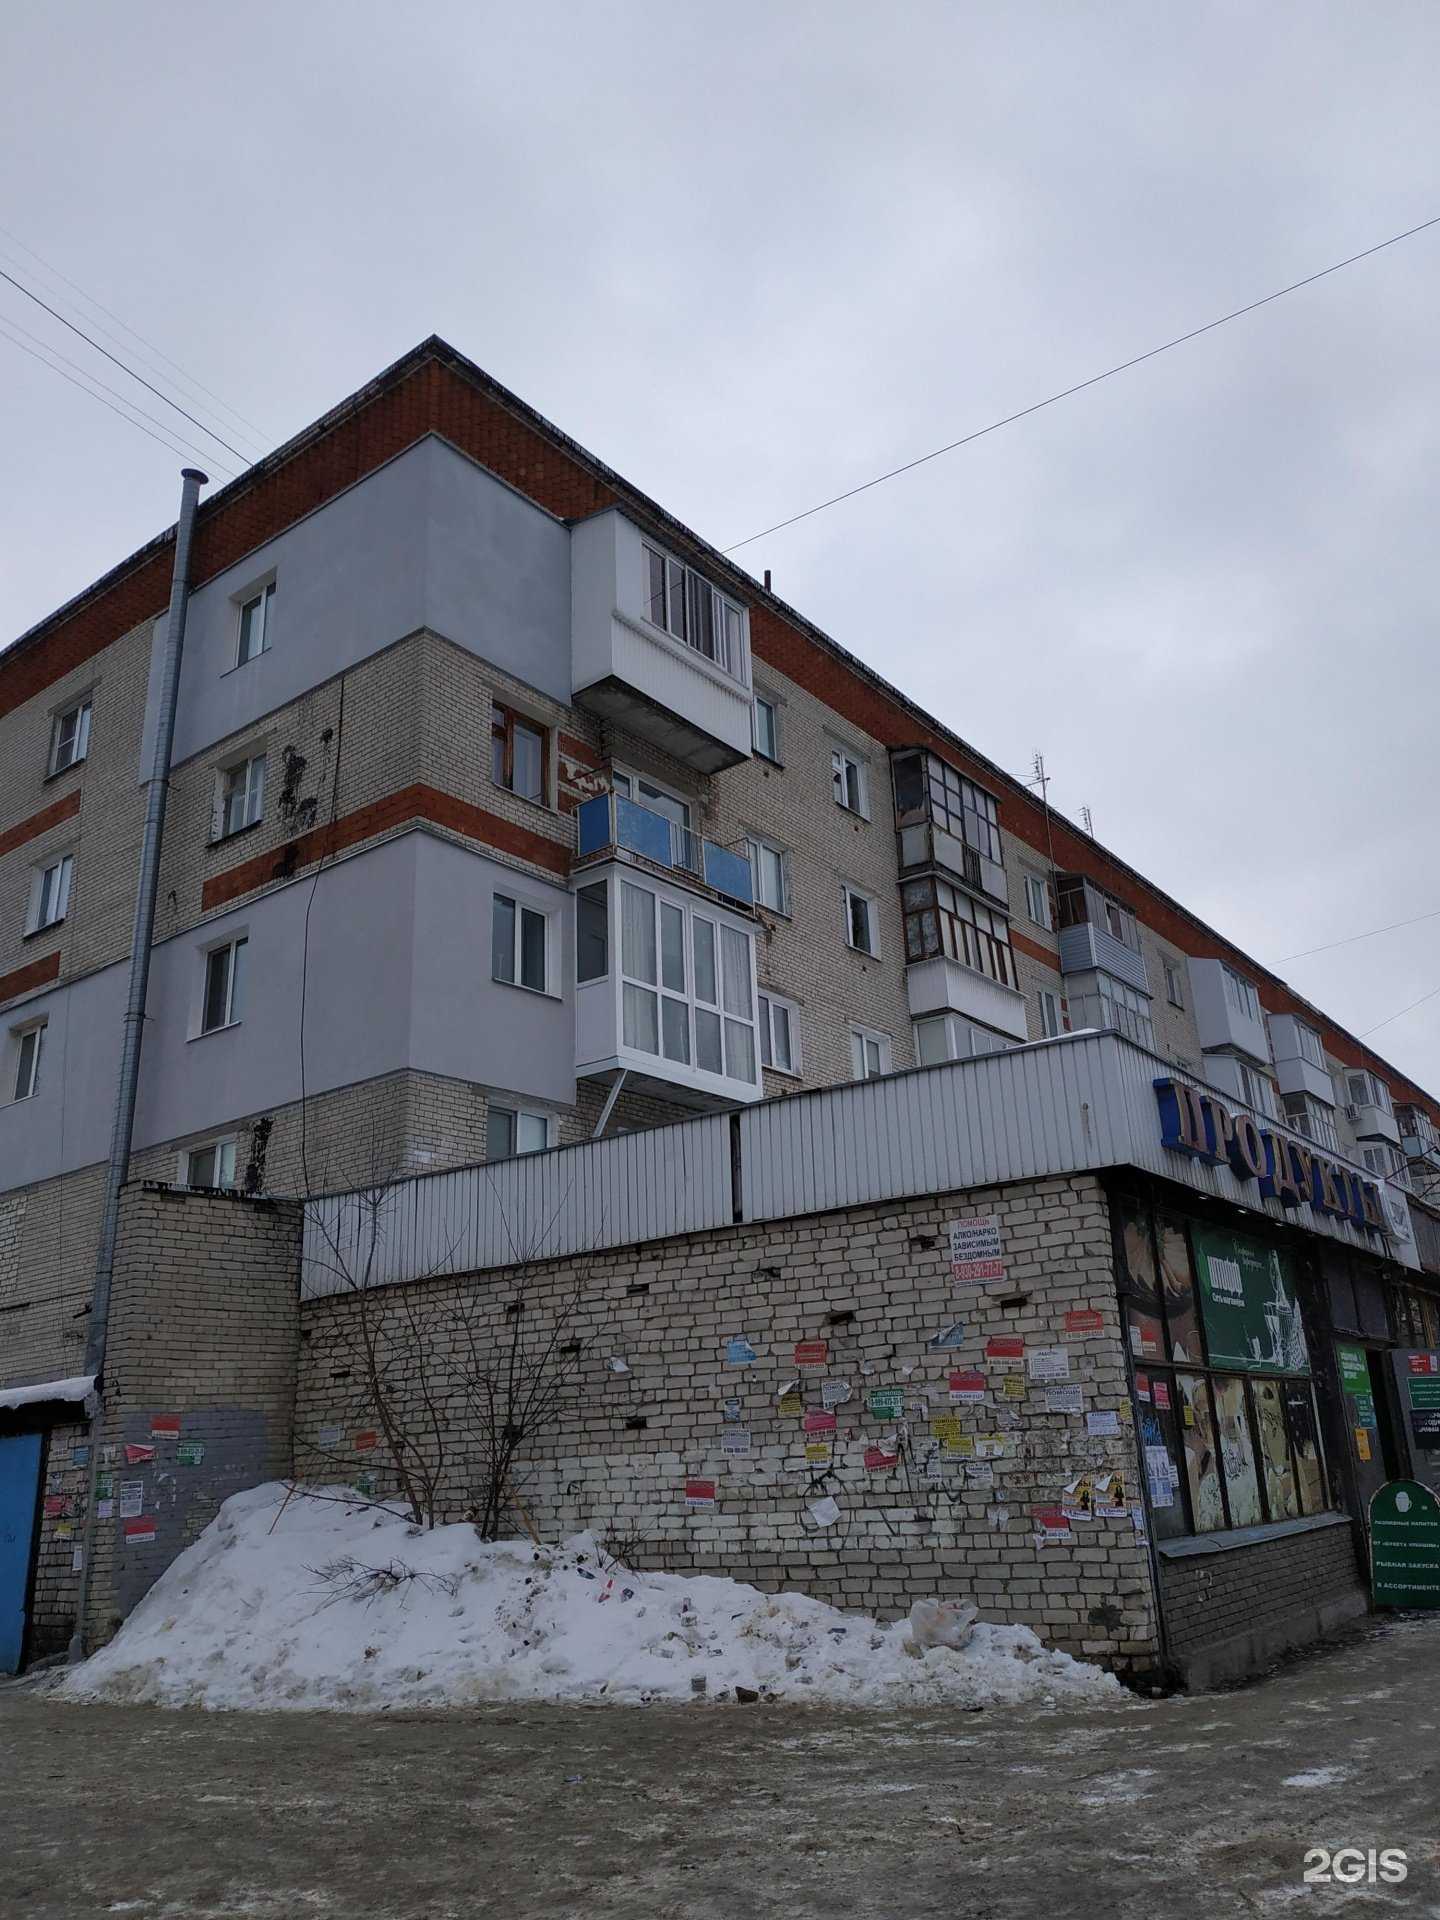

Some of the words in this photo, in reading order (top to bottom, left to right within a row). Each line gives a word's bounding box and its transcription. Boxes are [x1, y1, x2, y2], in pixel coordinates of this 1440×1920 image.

[1153, 1077, 1390, 1232] ПРОДУКТЫ
[953, 1238, 999, 1250] ЗАВИСИМЫМ
[954, 1249, 1000, 1262] БЕЗДОМНЫМ
